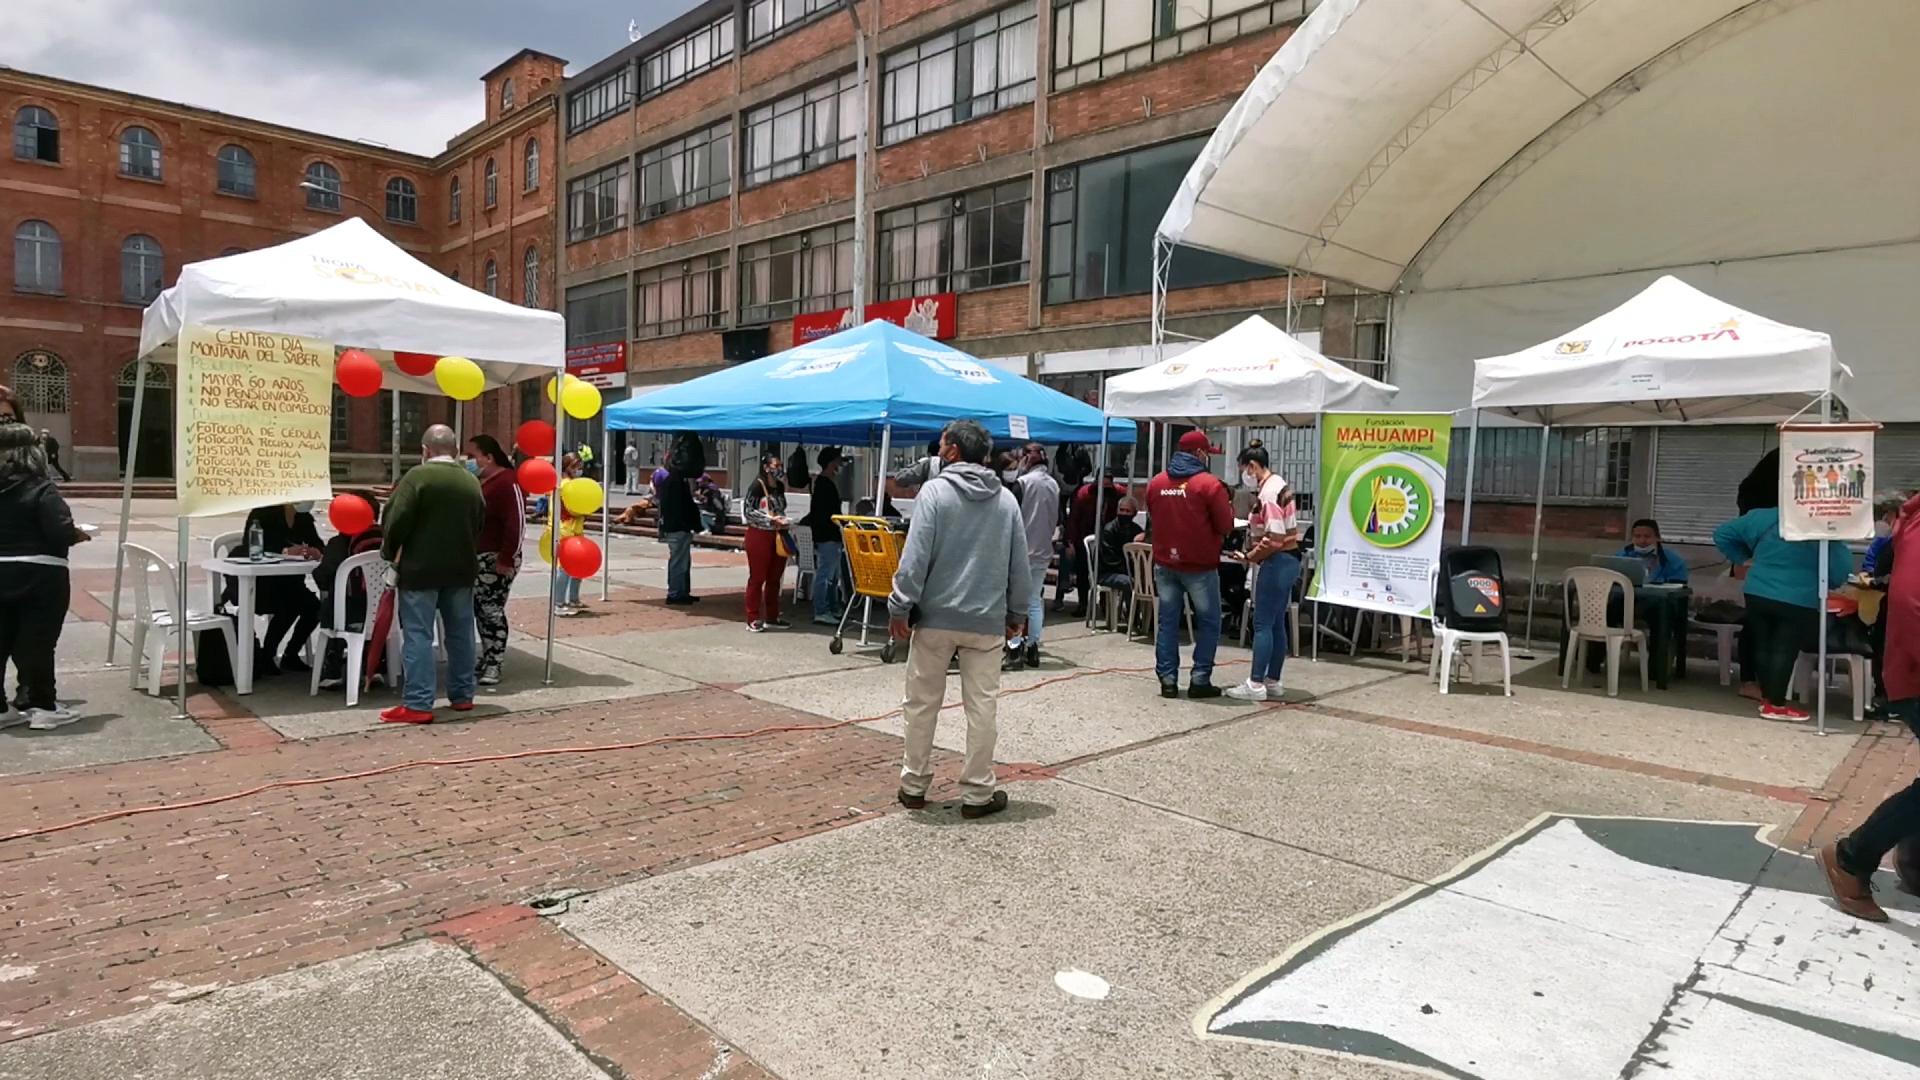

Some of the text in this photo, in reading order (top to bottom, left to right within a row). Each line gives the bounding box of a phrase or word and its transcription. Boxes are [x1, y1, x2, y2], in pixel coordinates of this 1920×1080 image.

[216, 328, 304, 352] CENTRO DIA
[190, 341, 321, 367] MONTAÑA DEL SABER
[201, 372, 305, 392] MAYOR 60 AÑOS
[200, 386, 309, 404] NO PENSIONADOS
[200, 397, 220, 408] NO
[224, 399, 259, 411] ESTAR
[262, 401, 277, 412] EN
[196, 421, 254, 436] FOTOCOPIA
[260, 427, 275, 438] DE
[1337, 427, 1435, 443] MAHUAMPI
[196, 433, 327, 450] FOTOCOPIA RECIBO AGUA
[197, 445, 251, 456] HISTORIA
[196, 455, 297, 470] FOTOCOPIA DE LOS
[197, 466, 275, 478] INTEGRANTES
[196, 476, 234, 487] DATOS
[201, 486, 221, 496] DEL
